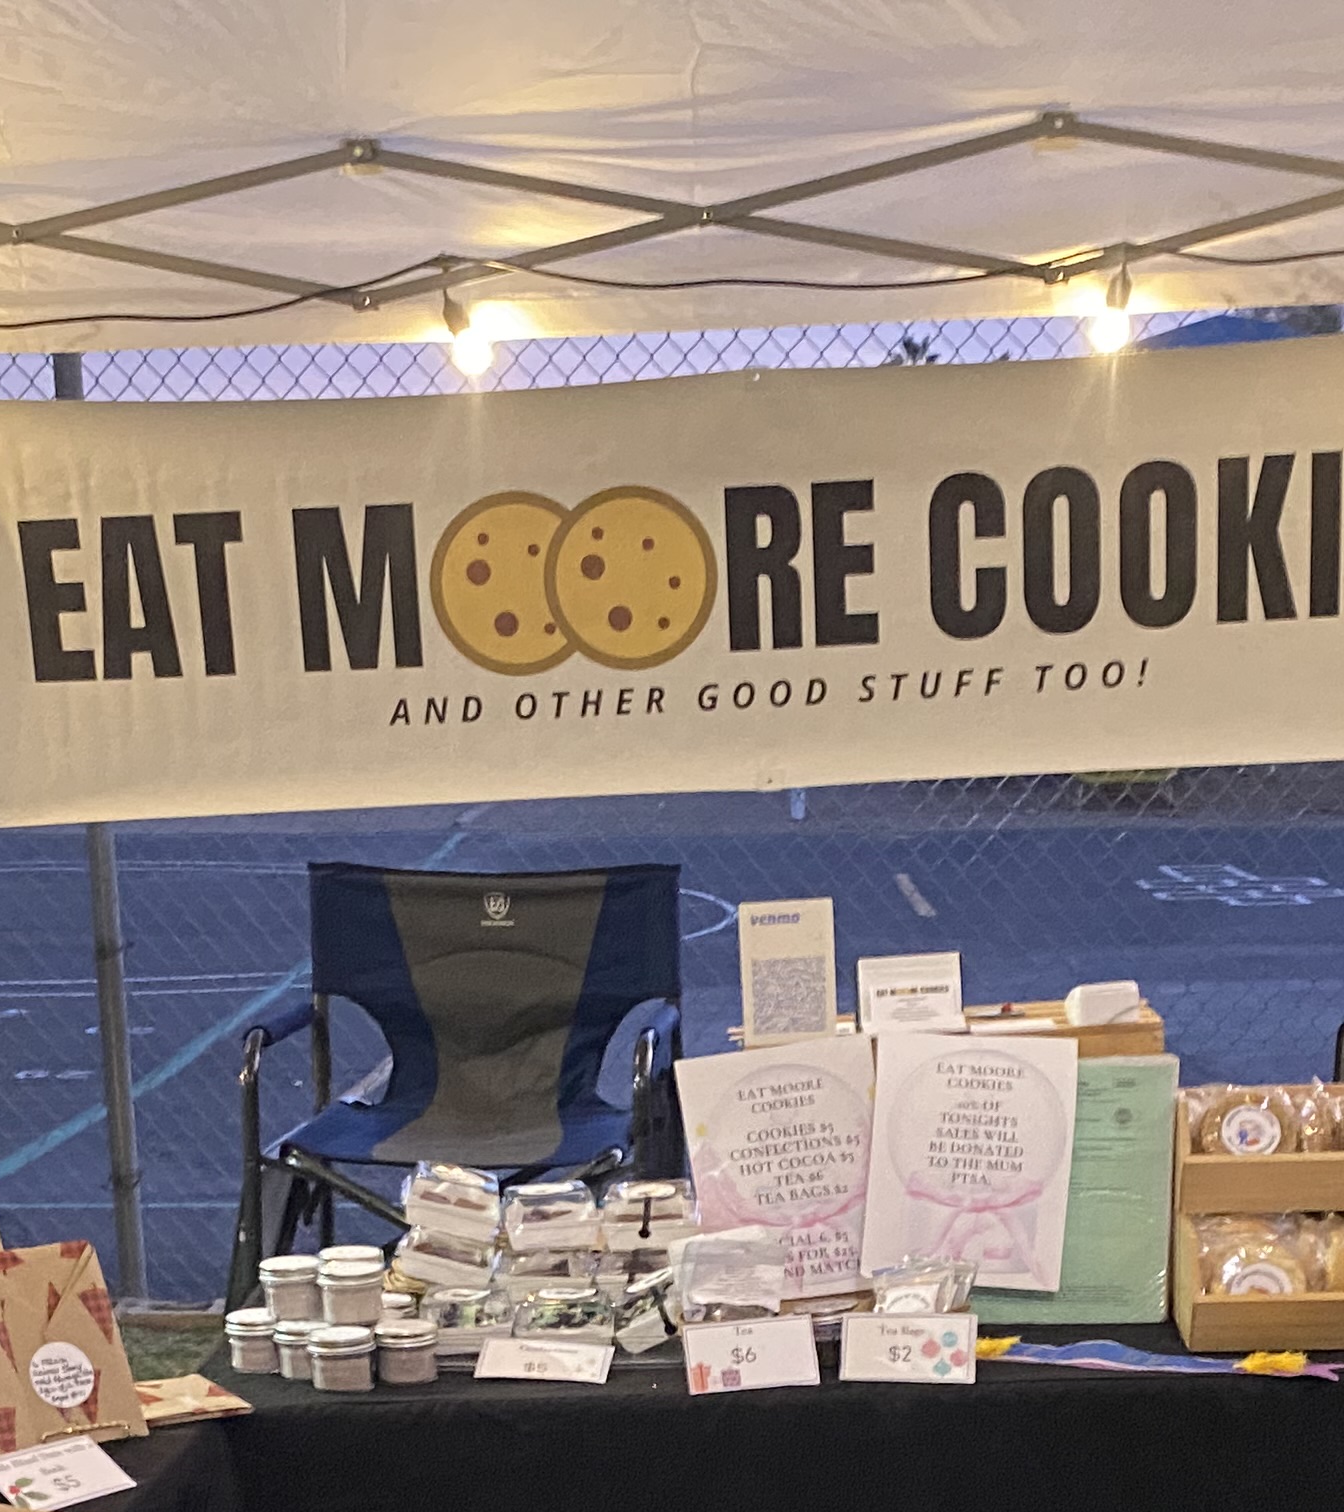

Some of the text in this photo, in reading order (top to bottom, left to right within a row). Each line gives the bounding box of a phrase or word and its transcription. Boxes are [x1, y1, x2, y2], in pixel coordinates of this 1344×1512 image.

[17, 510, 243, 682] EAT
[389, 656, 1152, 725] AND OTHER GOOD STUFF TOO!
[750, 912, 801, 926] venmo
[936, 1062, 1025, 1079] EAT MOORE
[737, 1079, 823, 1102] EAT MOORE
[947, 1077, 1013, 1092] COOKIES
[751, 1095, 816, 1114] COOKIES
[941, 1112, 1019, 1129] TONIGHTS
[746, 1123, 816, 1143] COOKIES
[936, 1127, 1019, 1144] SALES WILL
[730, 1137, 842, 1162] CONFECTIONS
[928, 1140, 1025, 1159] BE DONATED
[739, 1161, 773, 1177] HOT
[778, 1152, 836, 1172] COCOA
[927, 1155, 1024, 1173] TO THE MUM
[774, 1172, 805, 1188] TEA
[755, 1190, 786, 1206] TEA
[797, 1247, 831, 1261] FOR
[735, 1325, 753, 1337] Tea
[730, 1345, 757, 1366] $6
[887, 1345, 913, 1364] $2
[53, 1475, 82, 1492] $5
